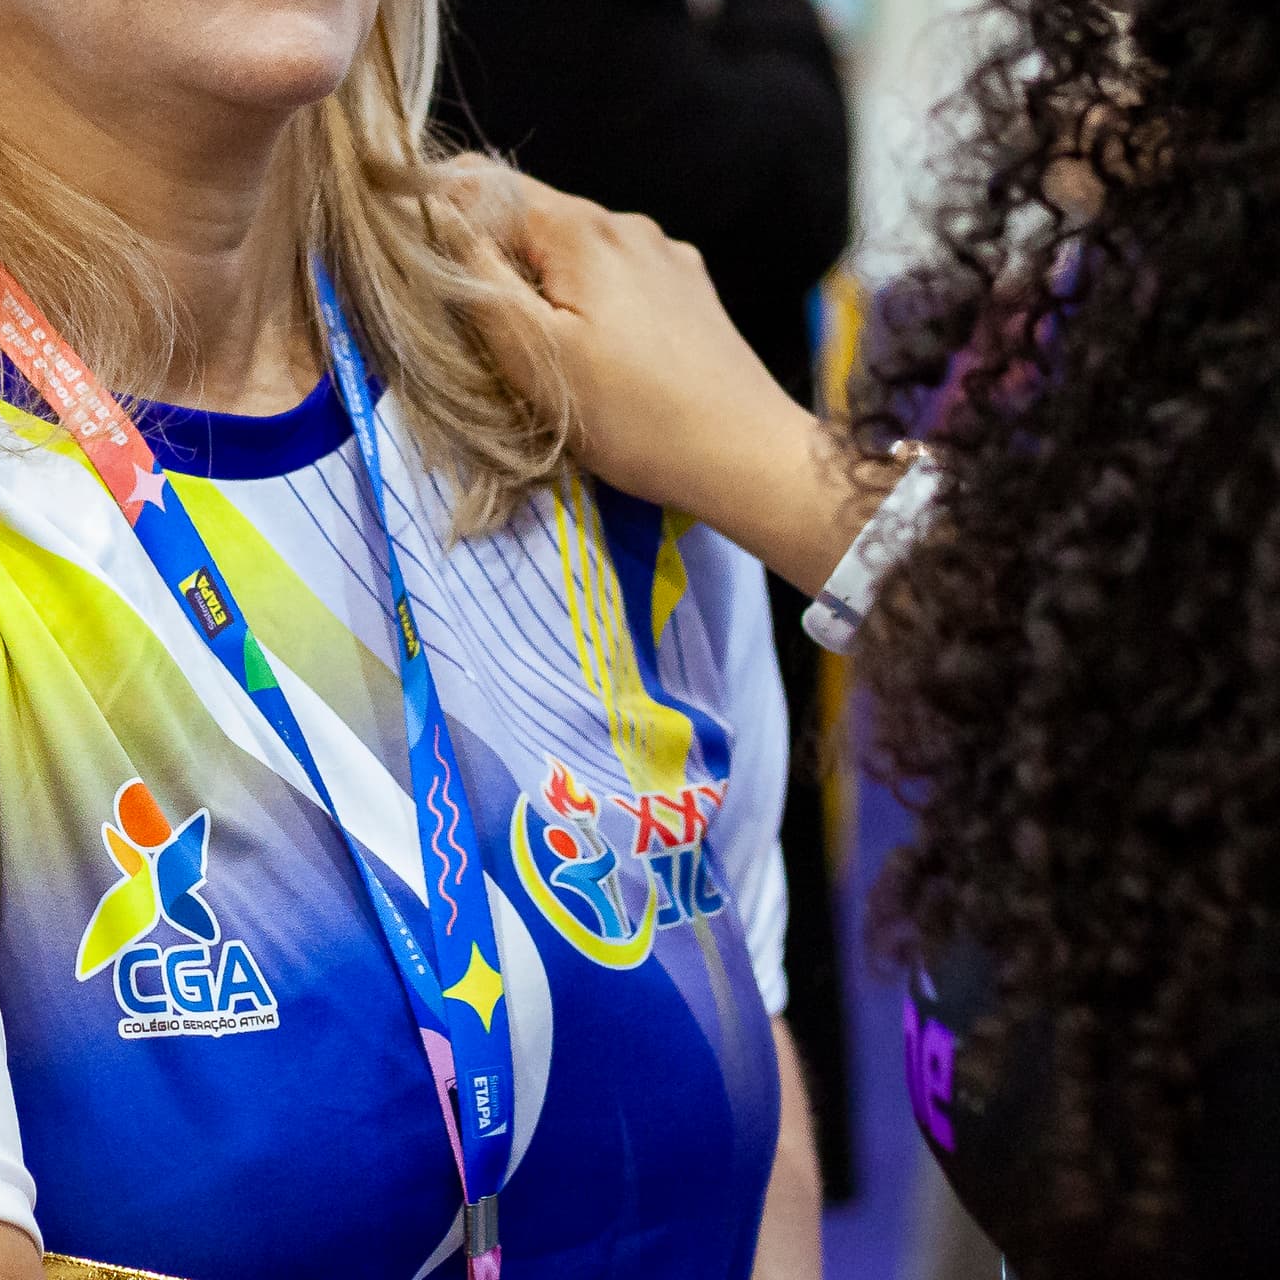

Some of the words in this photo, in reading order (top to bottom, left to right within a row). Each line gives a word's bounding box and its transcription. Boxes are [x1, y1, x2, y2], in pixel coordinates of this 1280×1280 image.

[197, 574, 227, 625] ETAPA
[114, 941, 278, 1016] CGA
[124, 1019, 180, 1035] COLÉGIO
[183, 1016, 237, 1033] GERAÇÃO
[240, 1013, 275, 1028] ATIVA
[473, 1076, 491, 1129] ETAPA
